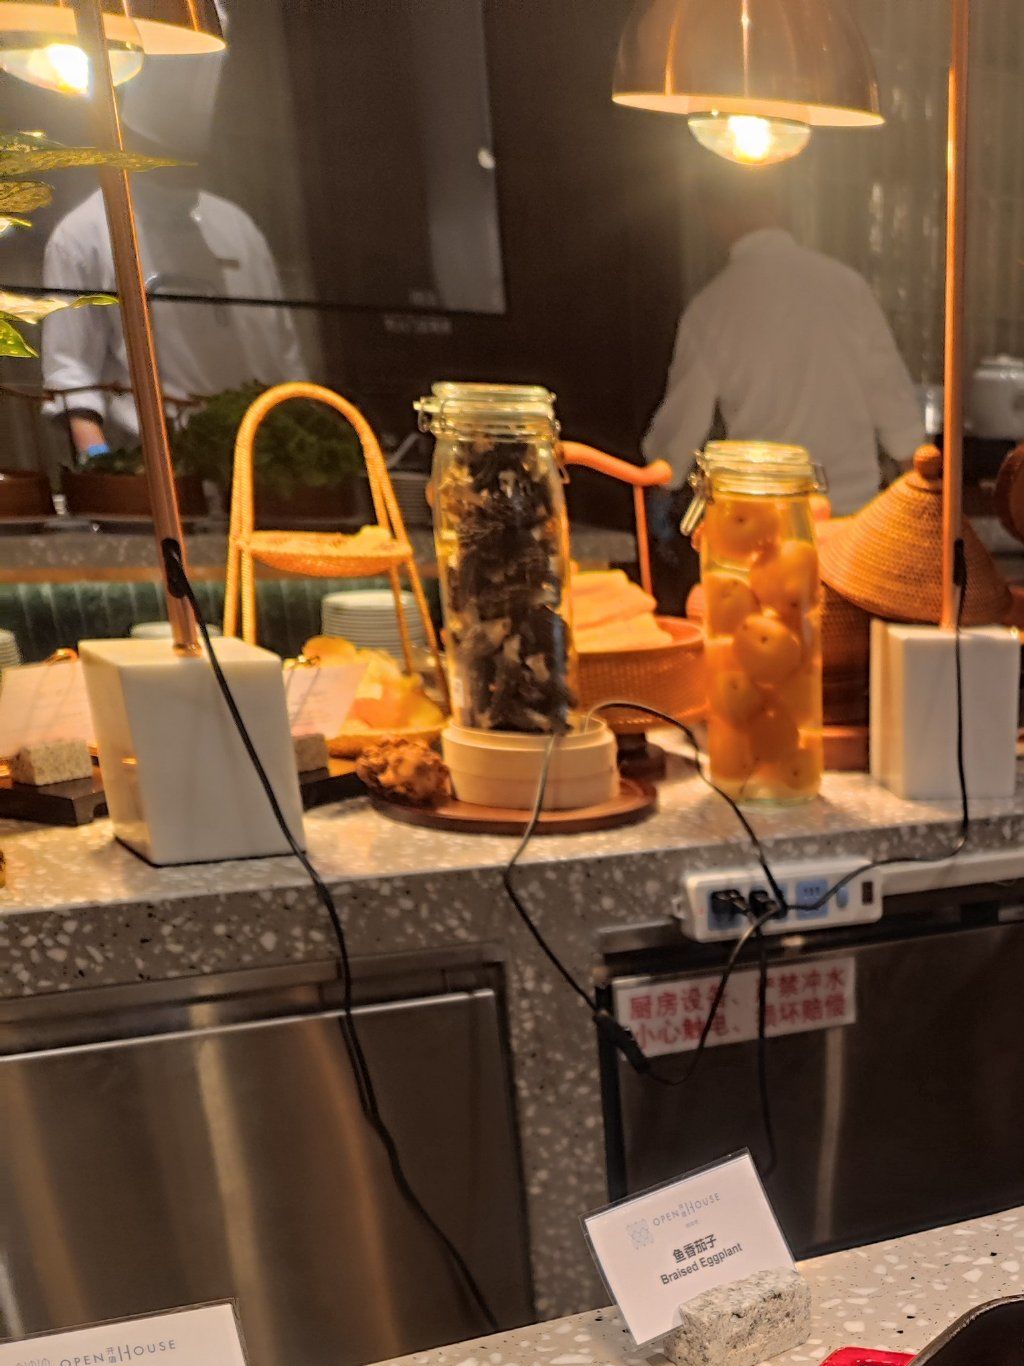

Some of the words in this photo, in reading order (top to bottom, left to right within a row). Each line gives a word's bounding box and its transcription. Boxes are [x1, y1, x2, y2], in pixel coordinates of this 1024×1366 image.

[652, 1210, 680, 1226] OPEN
[685, 1193, 721, 1215] HOUSE
[660, 1261, 699, 1285] Braised
[699, 1243, 743, 1267] Eggplant
[672, 1234, 717, 1263] 鱼香茄子
[118, 1339, 177, 1363] HOUSE
